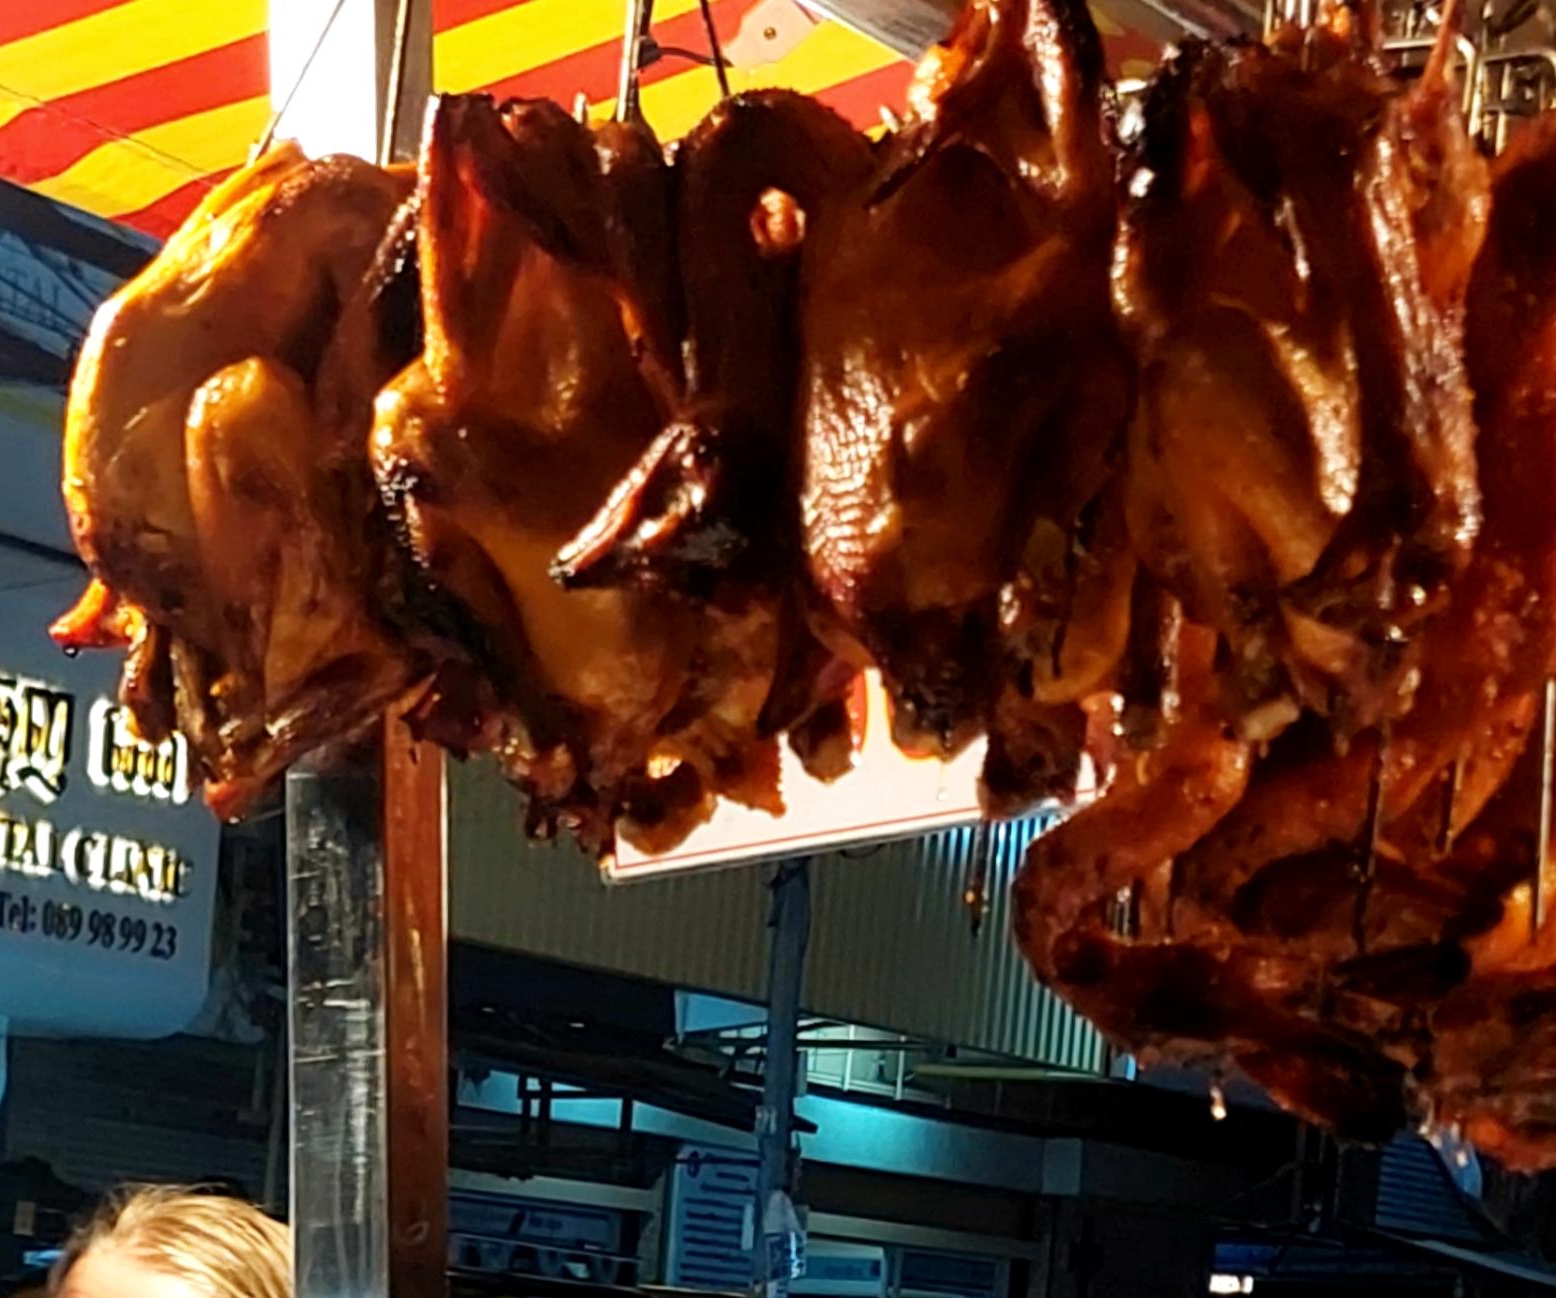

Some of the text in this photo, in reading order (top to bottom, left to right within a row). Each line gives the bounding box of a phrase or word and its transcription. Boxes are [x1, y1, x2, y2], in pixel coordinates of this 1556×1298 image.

[43, 901, 83, 941] 089
[88, 911, 115, 949] 98
[120, 916, 146, 954] 99
[151, 922, 178, 960] 23
